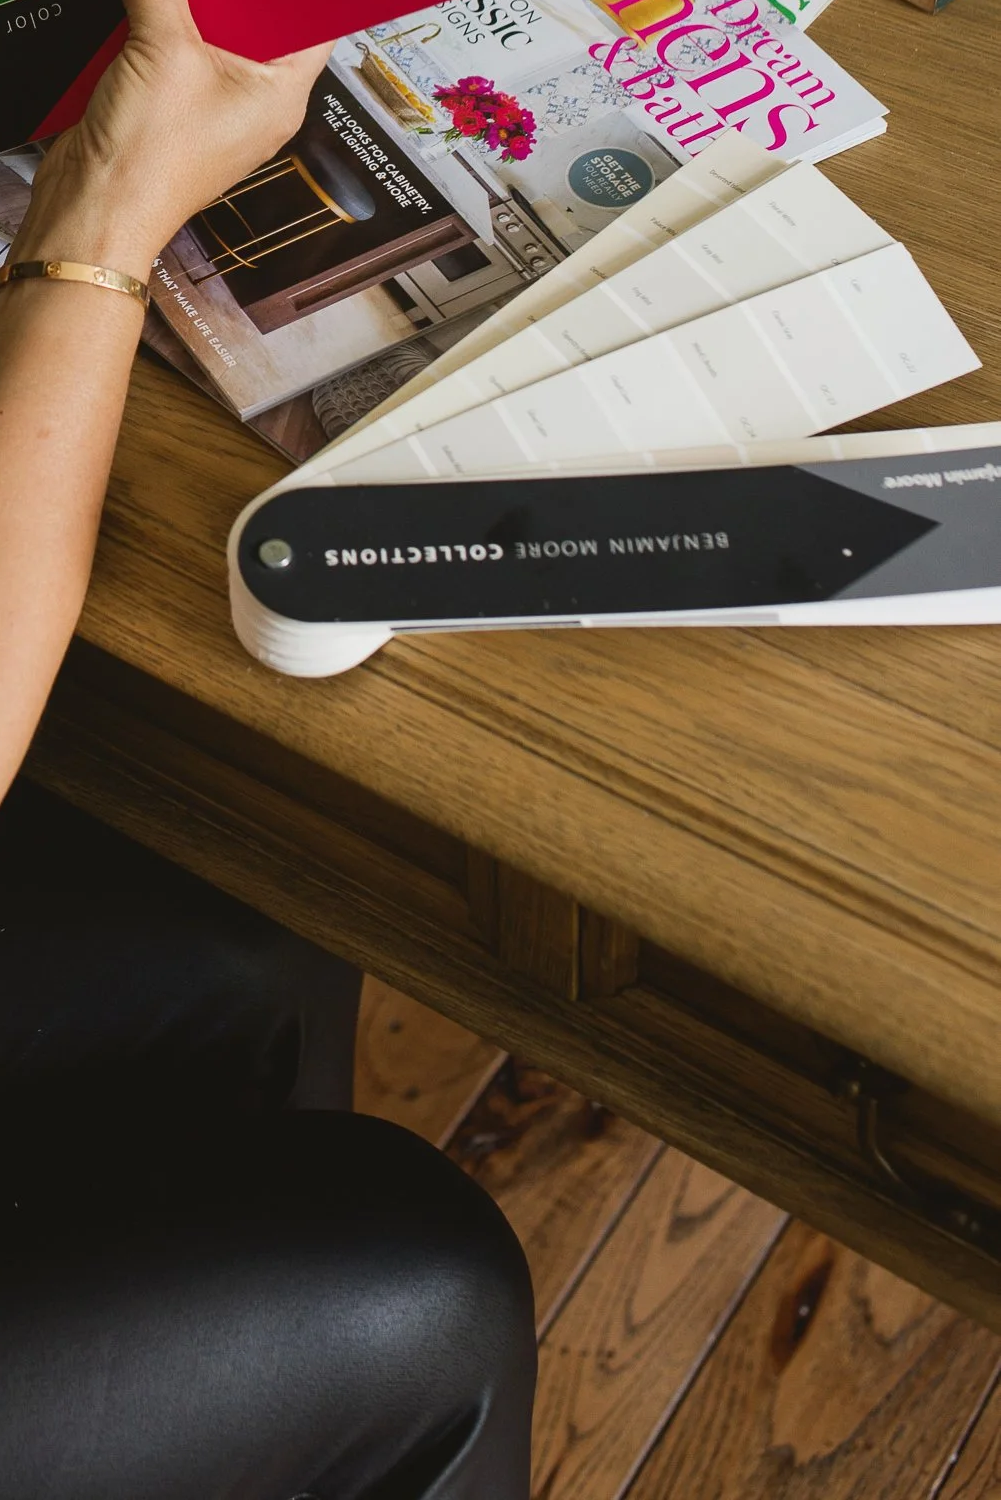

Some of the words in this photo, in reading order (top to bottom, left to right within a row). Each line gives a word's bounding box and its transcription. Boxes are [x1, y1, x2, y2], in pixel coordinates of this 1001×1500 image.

[6, 3, 62, 33] color
[587, 36, 638, 74] &
[322, 109, 343, 132] TILE,
[339, 130, 380, 172] LIGHTING
[375, 168, 387, 181] &
[383, 180, 412, 208] MORE
[323, 94, 347, 115] NEW
[342, 114, 373, 145] LOOKS
[367, 143, 389, 164] FOR
[384, 163, 433, 215] CABINETRY,
[603, 154, 624, 172] GET
[620, 172, 642, 191] THE
[582, 161, 600, 178] YOU
[597, 177, 623, 201] REALLY
[582, 176, 603, 195] NEED
[590, 157, 633, 198] STORAGE
[156, 268, 179, 294] THAT
[173, 291, 200, 319] MAKE
[193, 318, 213, 339] LIFE
[208, 336, 238, 369] EASIER
[324, 543, 504, 567] COLLECTIONS
[515, 538, 599, 560] MOORE
[609, 531, 730, 556] BENJAMIN
